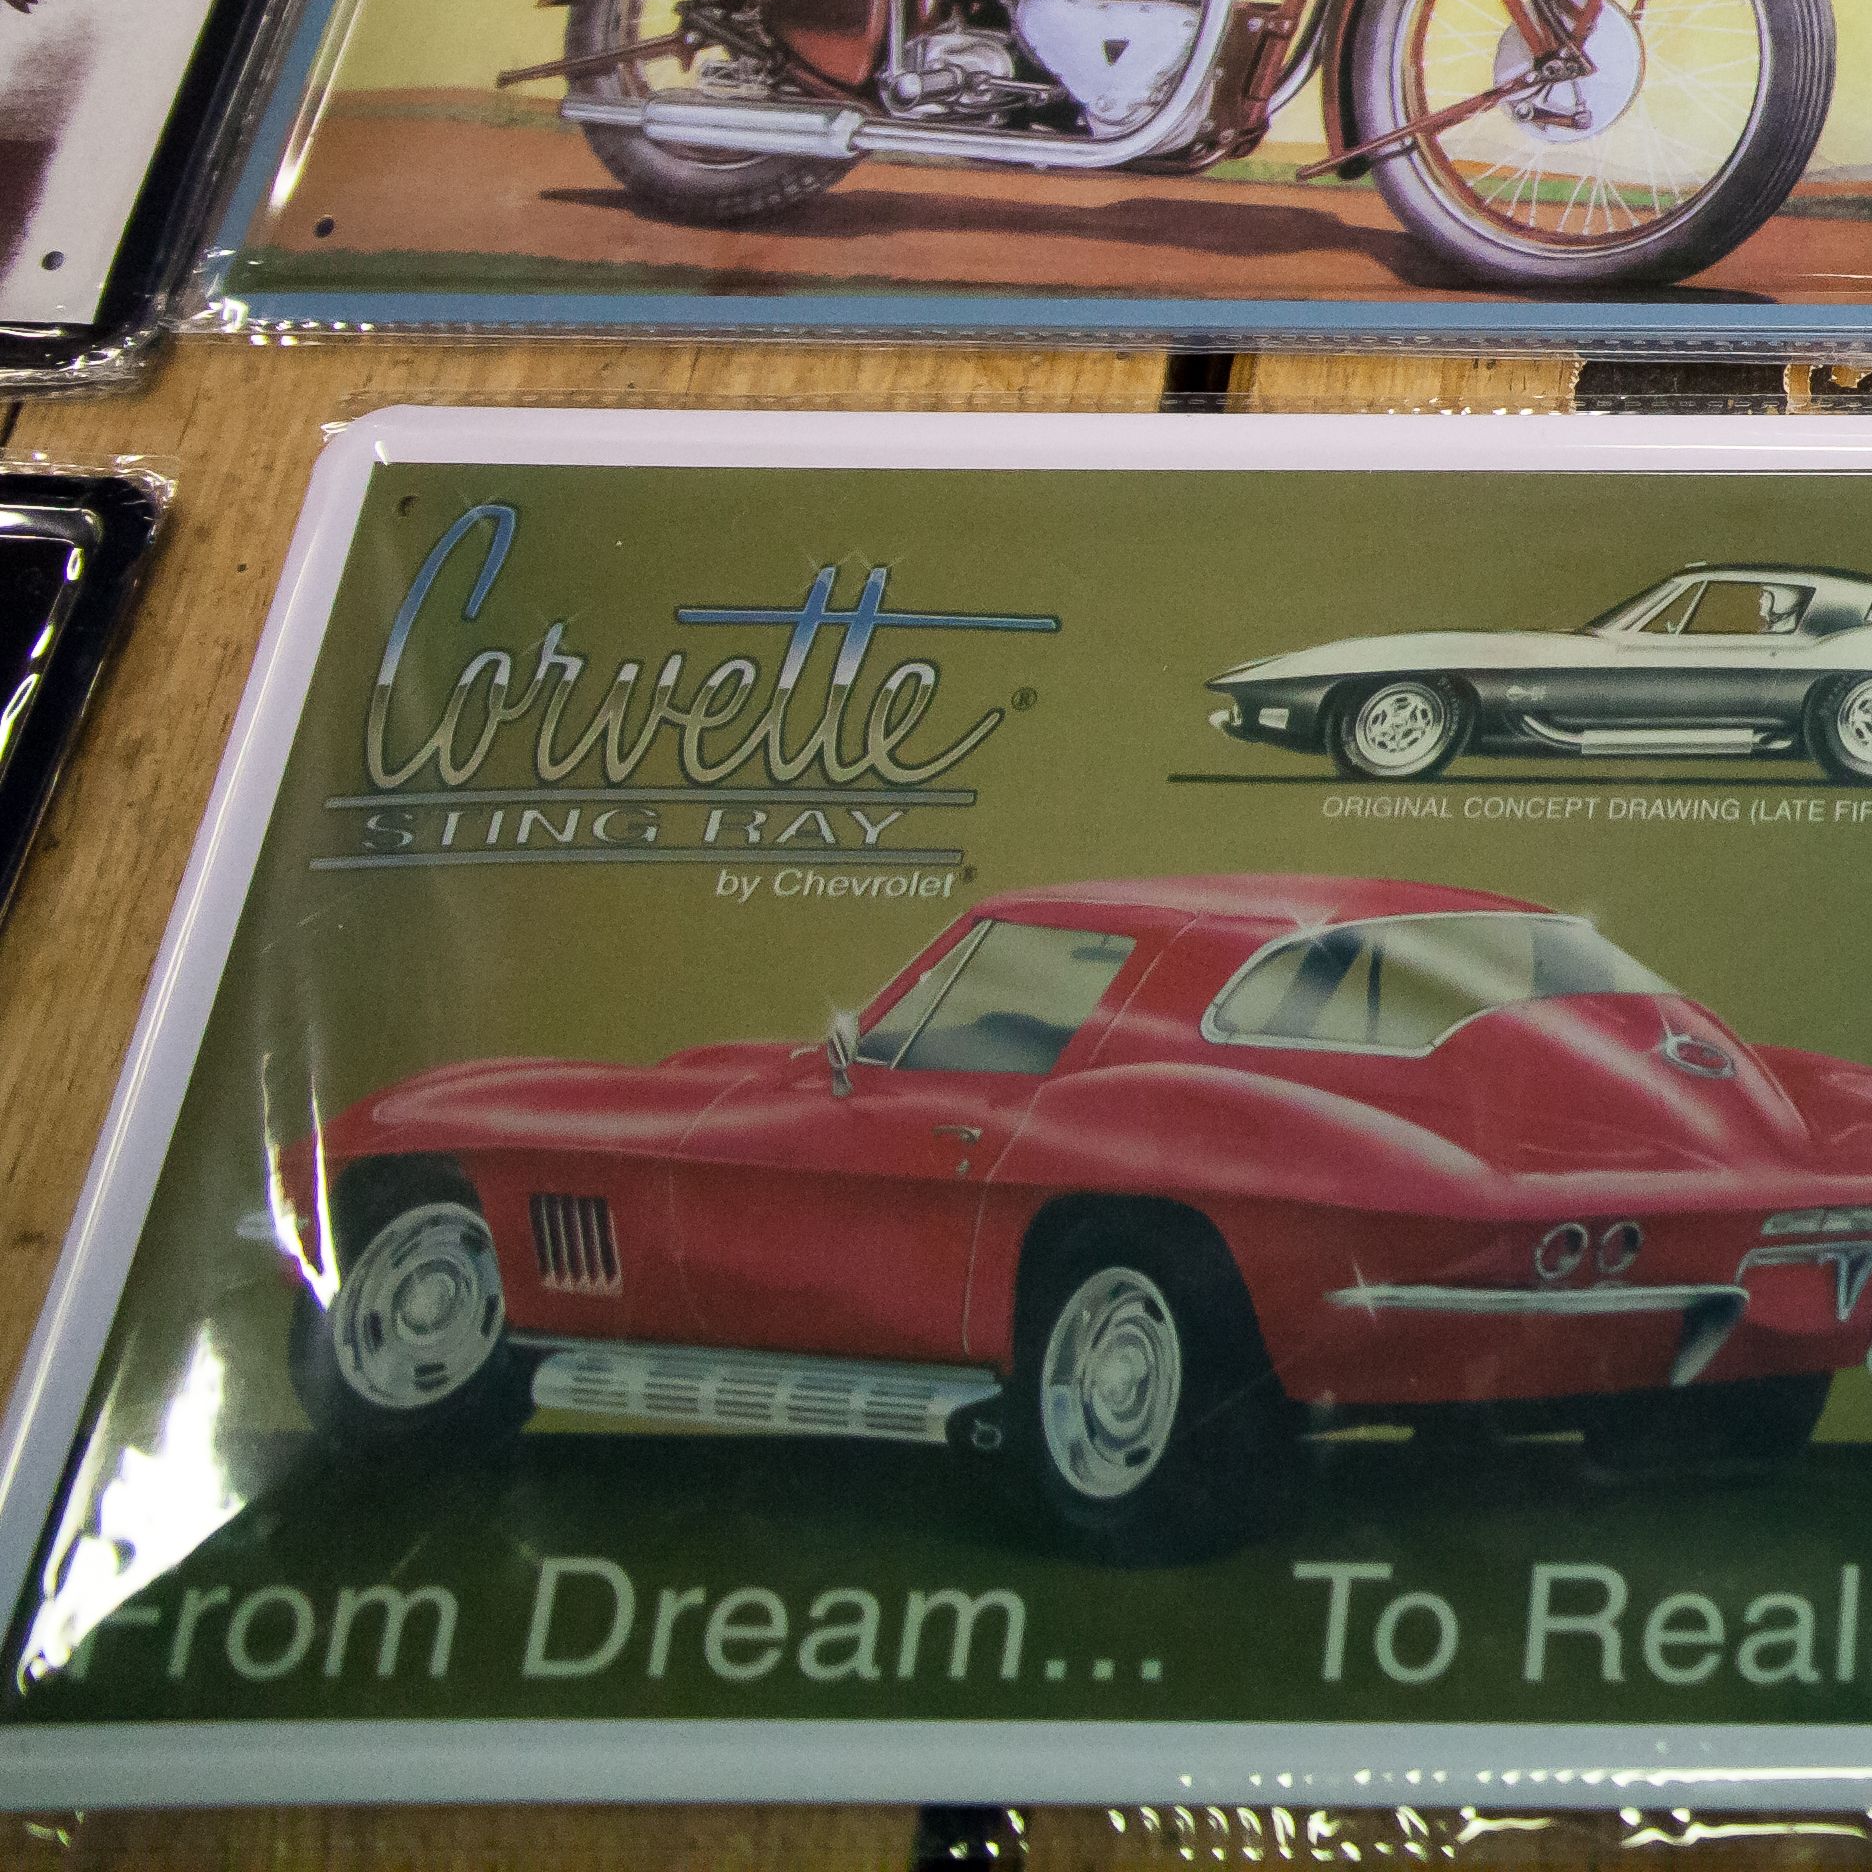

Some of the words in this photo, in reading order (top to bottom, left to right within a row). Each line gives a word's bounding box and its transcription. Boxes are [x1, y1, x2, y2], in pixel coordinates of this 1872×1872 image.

[367, 500, 1063, 790] Corvette
[363, 807, 662, 851] STING
[702, 807, 908, 846] RAY
[1321, 796, 1455, 820] ORIGINAL
[1462, 796, 1600, 820] CONCEPT
[1608, 797, 1741, 823] DRAWING
[1750, 798, 1826, 827] (LATE
[715, 869, 760, 905] by
[770, 869, 957, 900] Chevrolet
[1291, 1560, 1460, 1686] To
